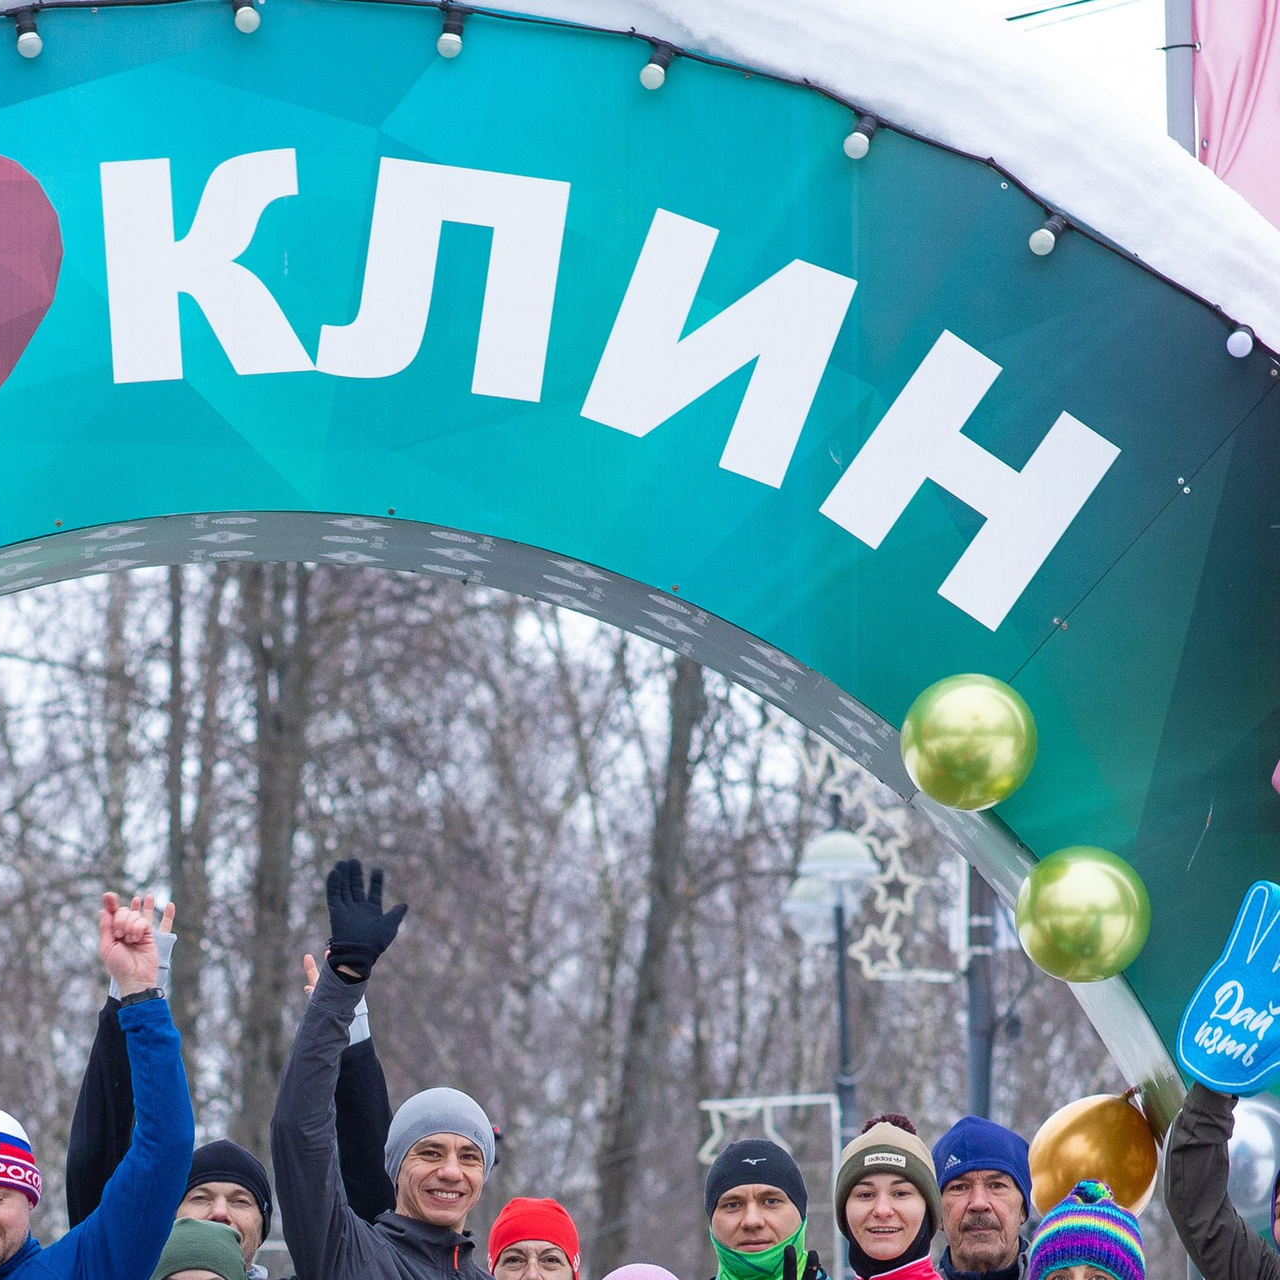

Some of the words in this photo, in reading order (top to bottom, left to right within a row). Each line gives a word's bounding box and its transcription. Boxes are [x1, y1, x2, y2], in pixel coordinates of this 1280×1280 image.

[100, 147, 1121, 632] КЛИН
[1210, 980, 1280, 1041] Дай
[1194, 1021, 1259, 1067] пять
[867, 1155, 893, 1164] adidas
